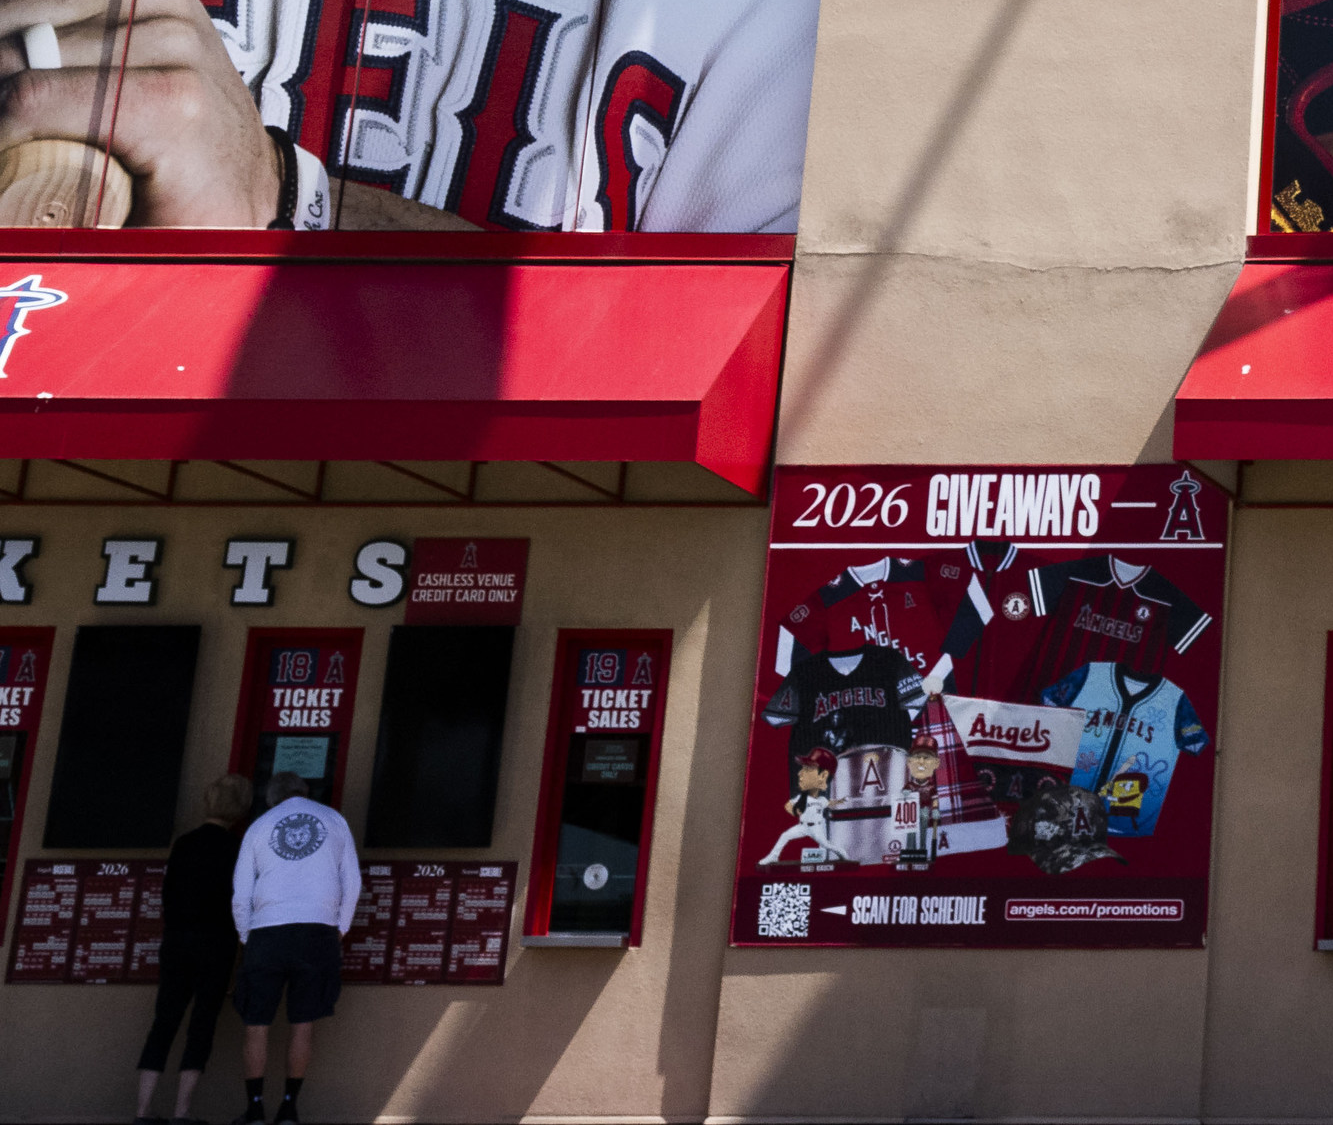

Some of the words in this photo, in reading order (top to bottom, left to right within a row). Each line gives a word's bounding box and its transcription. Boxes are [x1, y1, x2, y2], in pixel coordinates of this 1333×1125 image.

[792, 482, 913, 528] 2026
[925, 472, 1101, 538] GIVEAWAYS
[1159, 470, 1206, 541] A
[417, 573, 475, 587] CASHLESS
[476, 573, 516, 587] VENUE
[411, 589, 453, 602] CREDIT
[455, 589, 485, 602] CARD
[487, 589, 518, 602] ONLY
[1073, 603, 1145, 643] ANGELS
[276, 651, 313, 683] 18
[585, 652, 619, 683] 19
[273, 688, 344, 708] TICKET
[581, 689, 652, 709] TICKET
[813, 686, 887, 723] ANGELS
[278, 708, 332, 728] SALES
[587, 709, 641, 729] SALES
[1088, 709, 1155, 744] ANGELS
[968, 713, 1051, 751] Angels
[859, 755, 886, 793] A
[895, 801, 917, 825] 400
[96, 863, 130, 876] 2026
[413, 864, 445, 877] 2026
[851, 895, 889, 925] SCAN
[892, 895, 919, 925] FOR
[920, 895, 987, 925] SCHEDULE
[1009, 901, 1179, 919] angels.com/promotions
